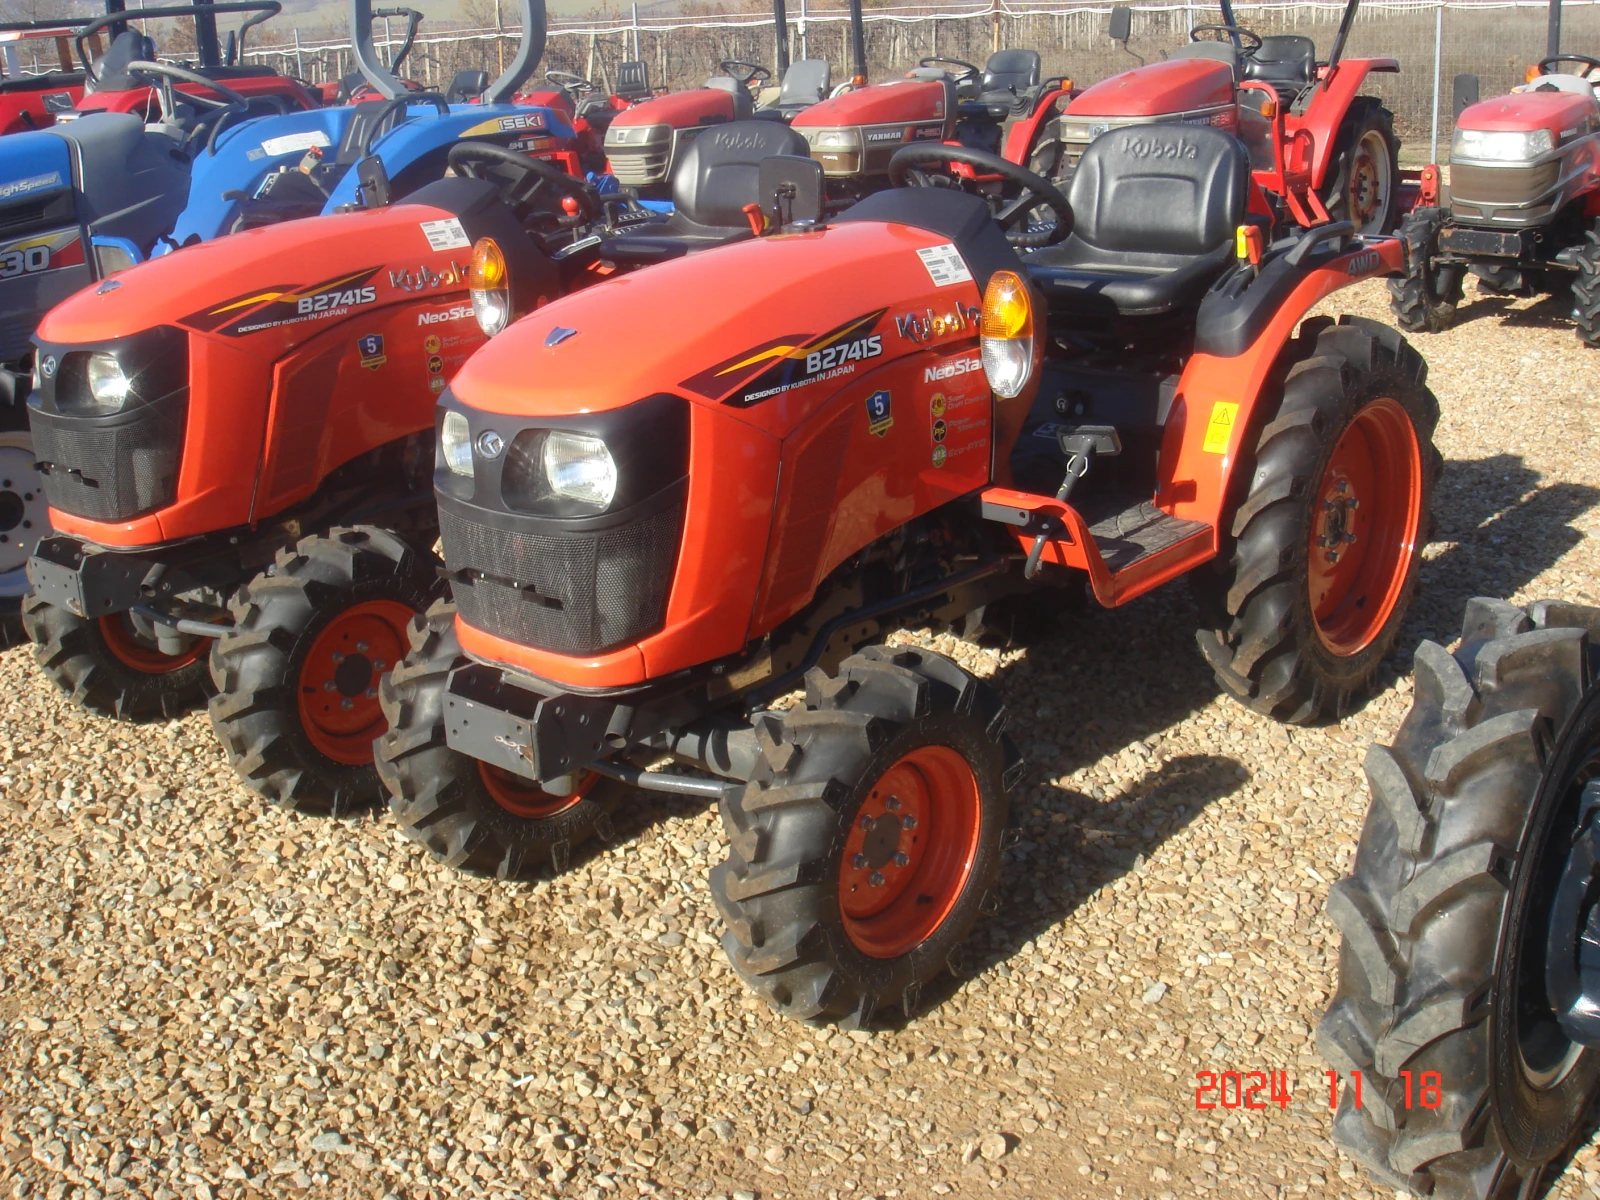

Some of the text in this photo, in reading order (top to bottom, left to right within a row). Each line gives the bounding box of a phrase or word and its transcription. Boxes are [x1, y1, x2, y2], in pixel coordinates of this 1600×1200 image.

[498, 115, 542, 130] ISEKI
[714, 132, 767, 149] Kubota
[867, 131, 901, 142] YANMAR
[1121, 136, 1199, 159] Kubota
[1347, 250, 1380, 275] 4WD
[297, 286, 376, 314] B2741S
[238, 321, 273, 333] DESIGNED
[282, 316, 308, 325] KUBOTA
[308, 312, 318, 321] IN
[318, 307, 348, 319] JAPAN
[418, 306, 475, 326] NeoSta
[366, 337, 377, 354] 5
[806, 335, 882, 374] B2741S
[744, 364, 855, 402] DESIGNED BY KUBOTA IN JAPAN
[874, 394, 885, 416] 5
